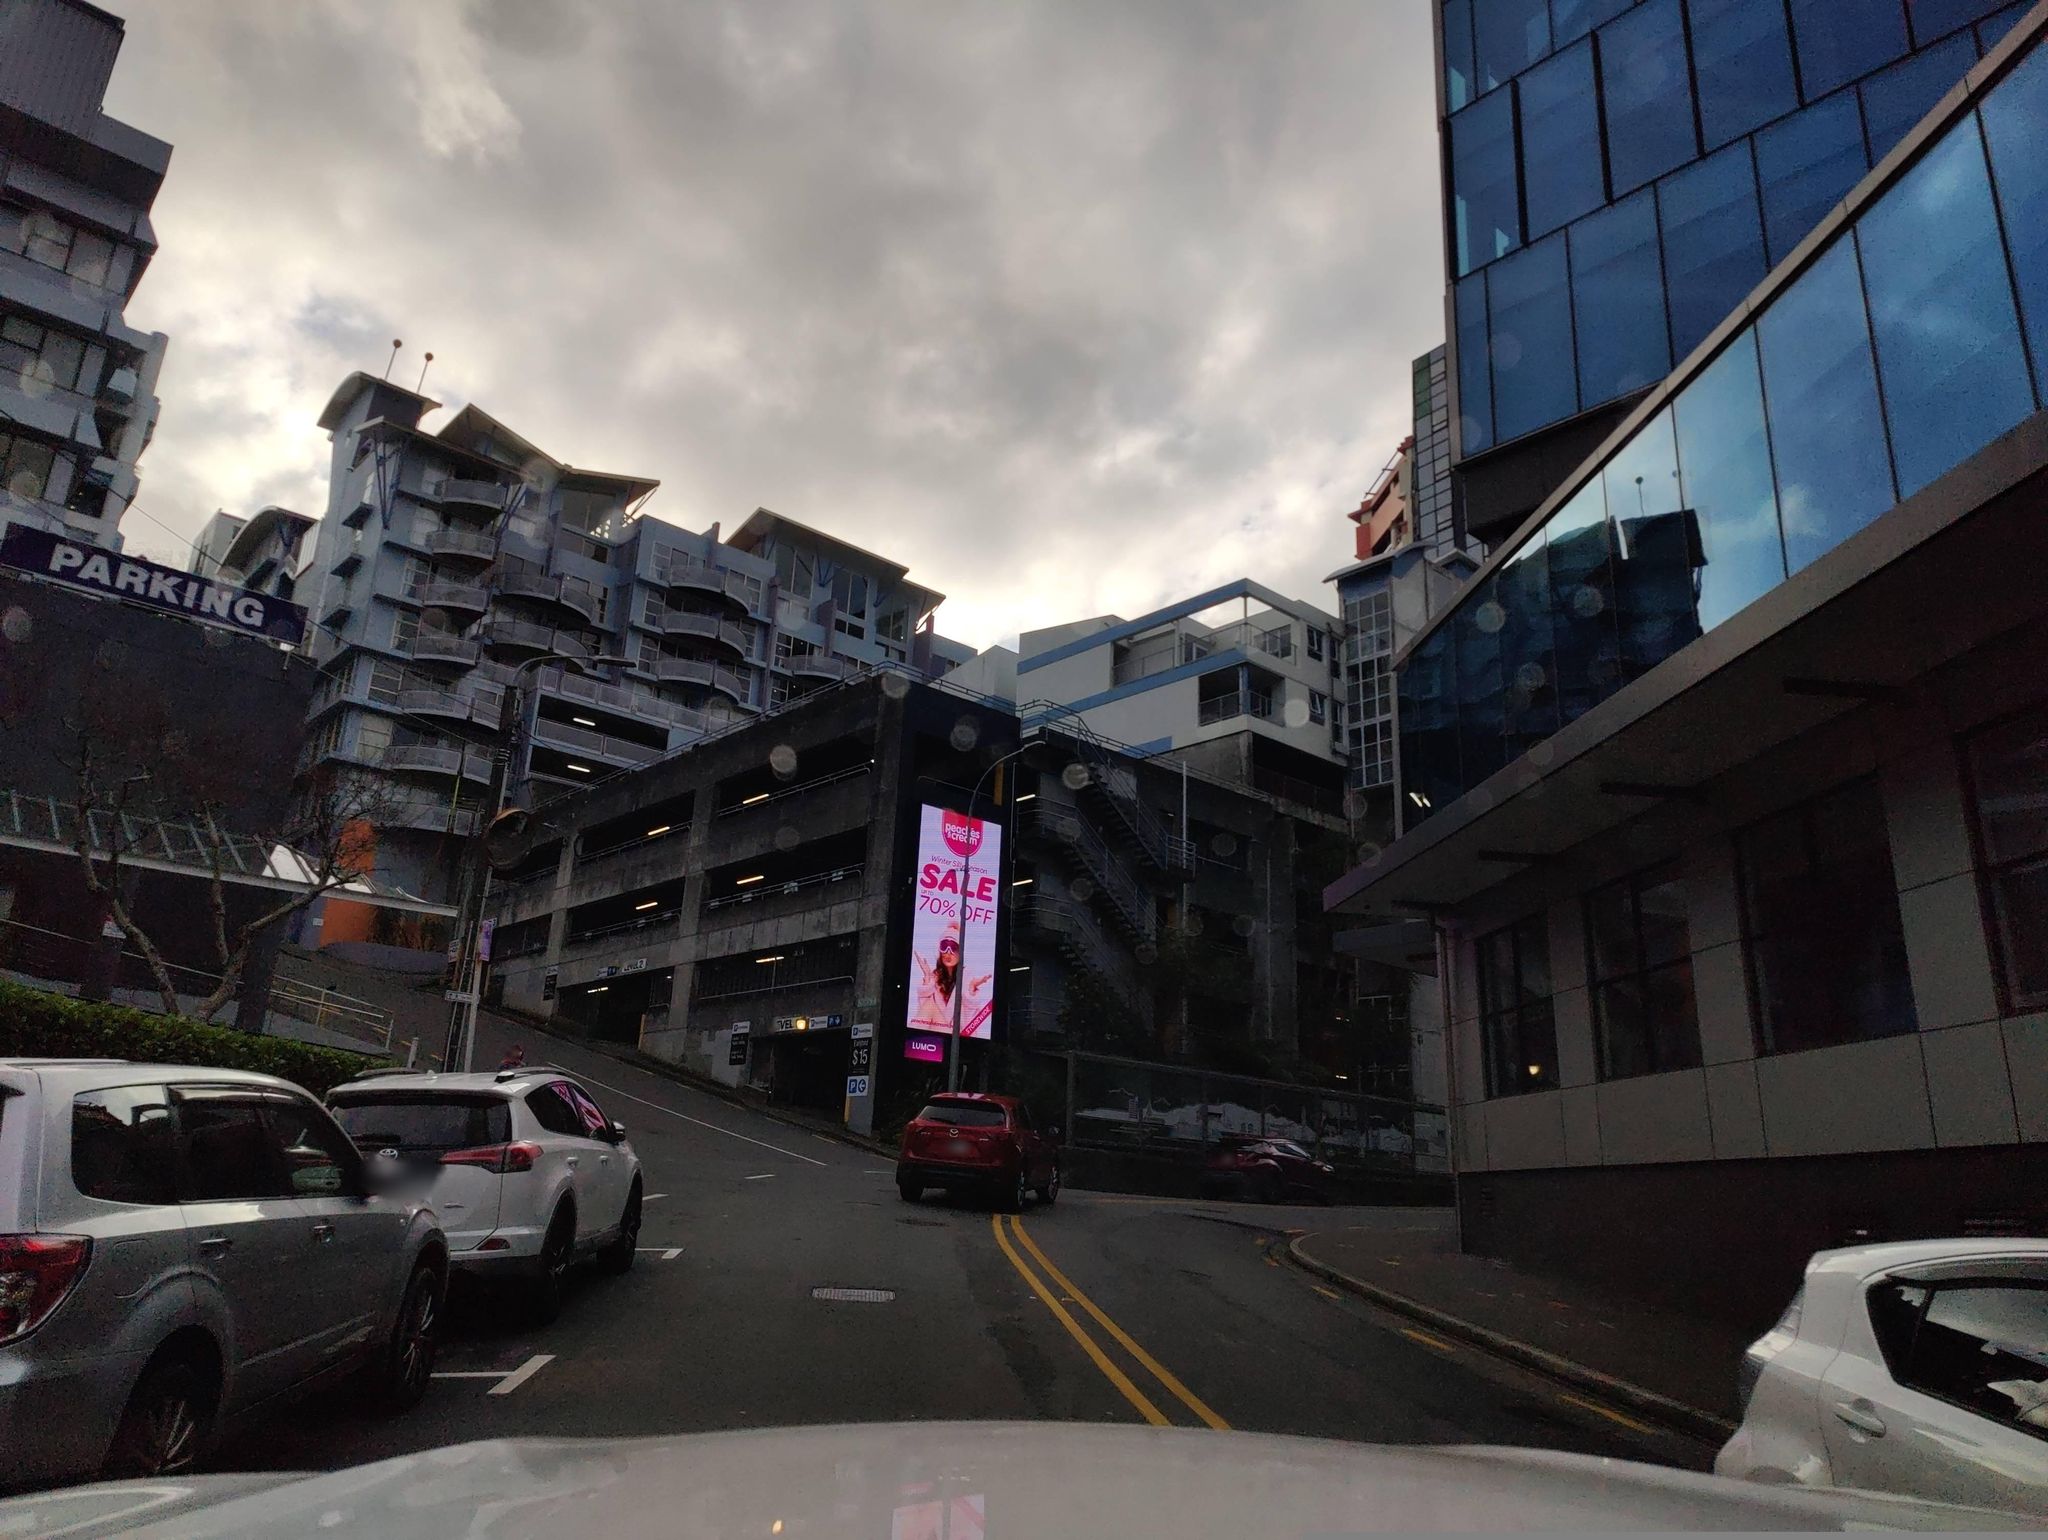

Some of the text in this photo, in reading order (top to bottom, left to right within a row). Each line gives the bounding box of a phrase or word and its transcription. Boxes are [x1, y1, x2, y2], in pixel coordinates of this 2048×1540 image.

[49, 544, 264, 627] PARKING
[919, 863, 997, 902] SALE
[967, 864, 988, 875] eason
[919, 895, 995, 925] 70% OFF
[912, 1042, 936, 1052] LUMO
